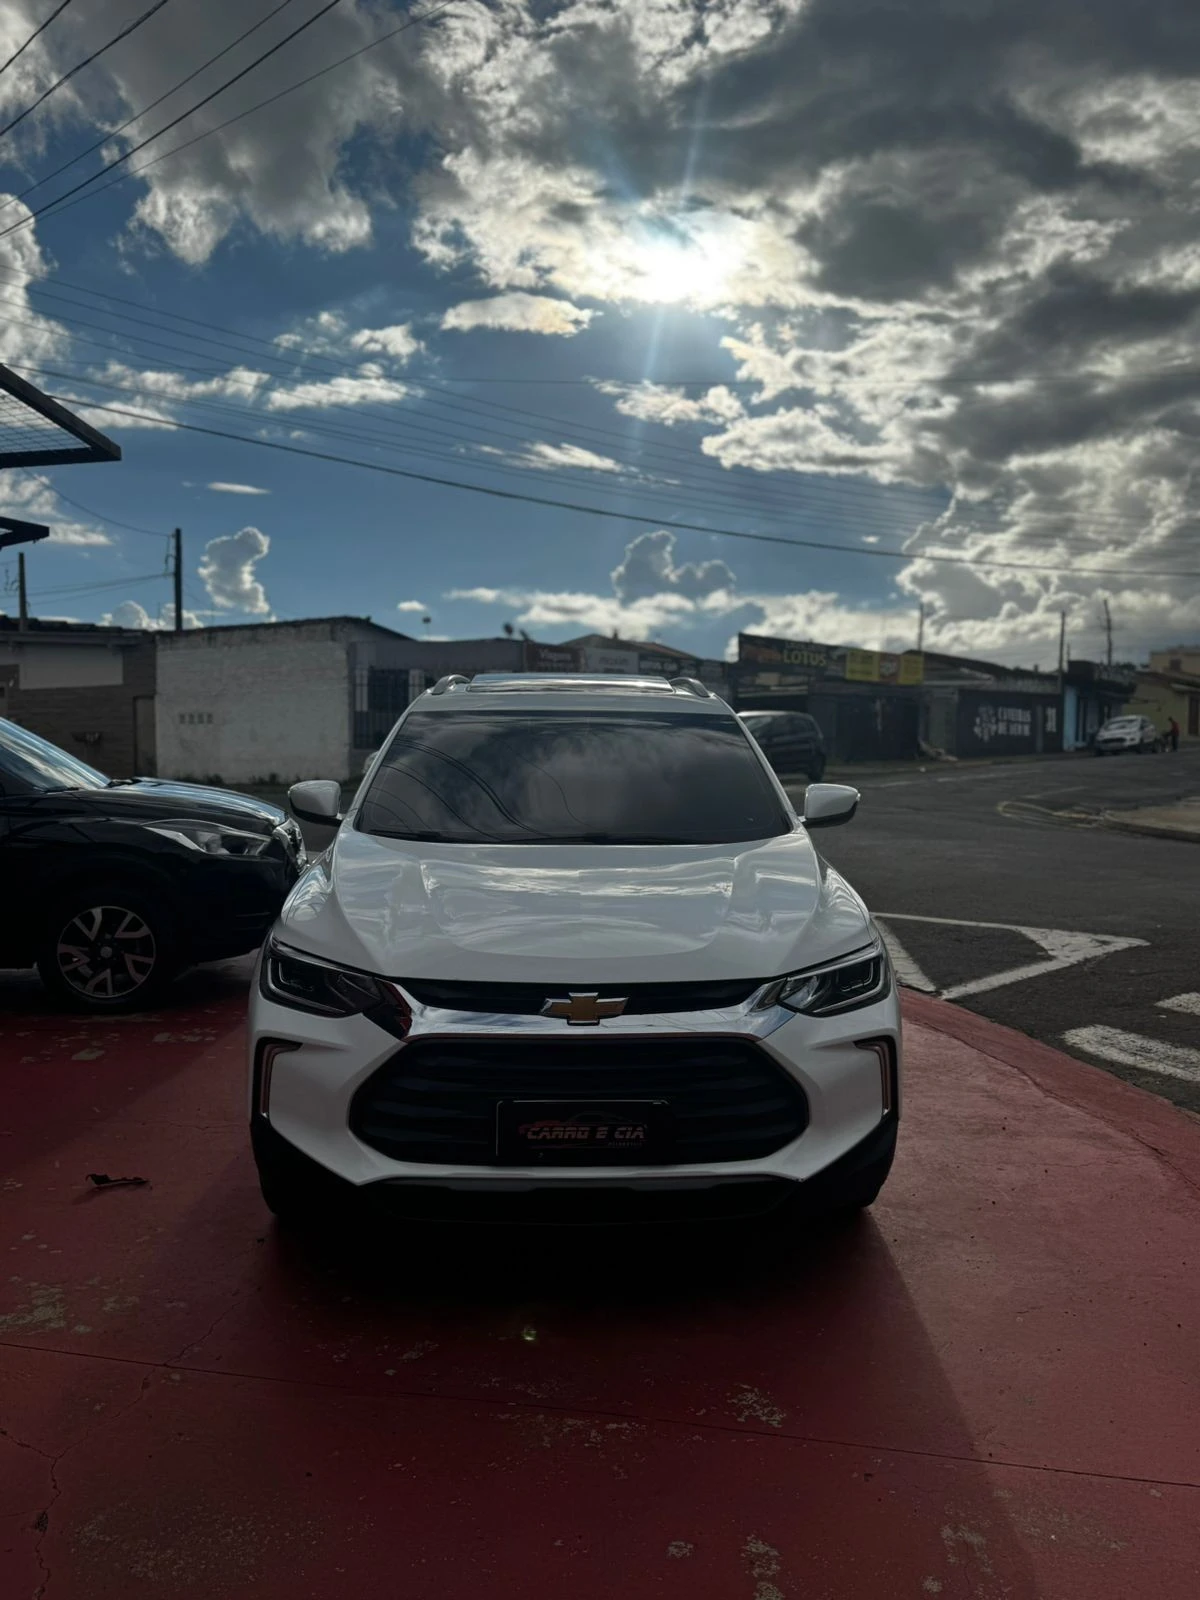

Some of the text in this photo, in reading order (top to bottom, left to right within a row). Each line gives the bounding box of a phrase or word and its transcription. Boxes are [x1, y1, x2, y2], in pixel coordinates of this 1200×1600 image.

[782, 648, 827, 668] LOTUS
[526, 1126, 591, 1140] CARRO
[613, 1126, 645, 1140] CIA
